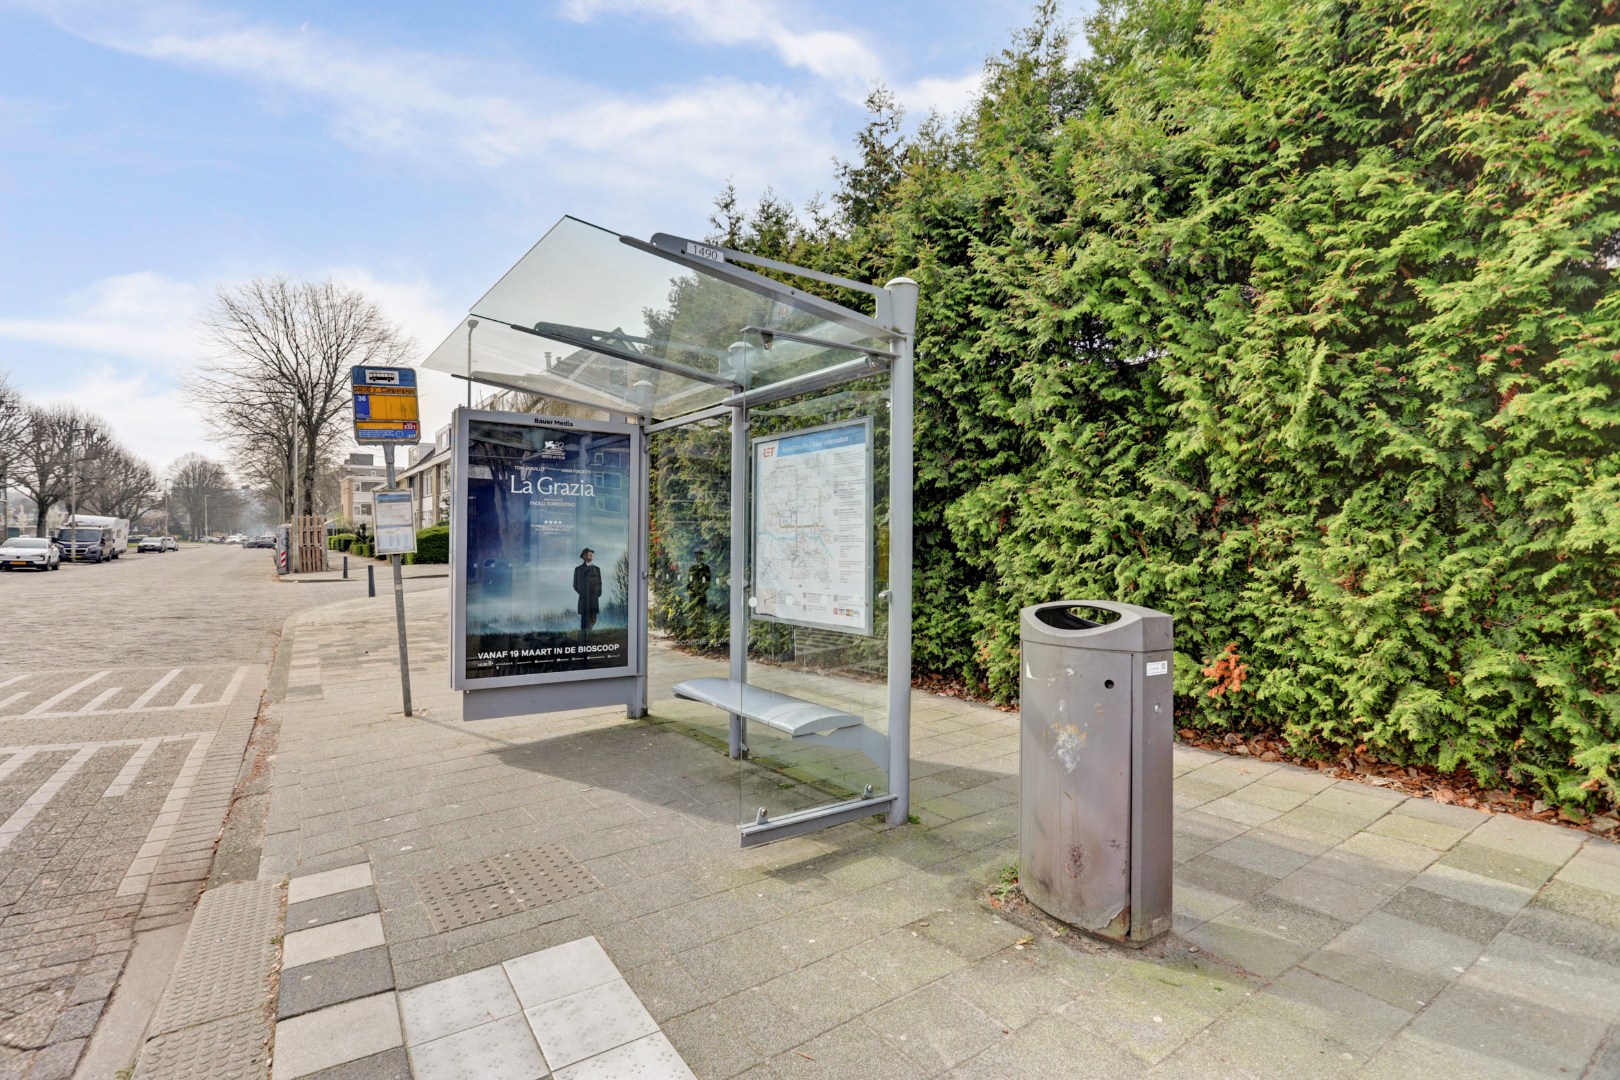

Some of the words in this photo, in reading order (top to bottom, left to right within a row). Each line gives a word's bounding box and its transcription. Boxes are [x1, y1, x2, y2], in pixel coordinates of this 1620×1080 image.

[693, 245, 718, 260] 1490
[510, 475, 533, 494] La
[537, 476, 595, 497] Grazia
[477, 650, 508, 660] VANAF
[510, 650, 519, 658] 19
[521, 647, 552, 657] MAART
[553, 646, 563, 655] IN
[564, 646, 576, 654] DE
[577, 643, 620, 654] BIOSCOOP
